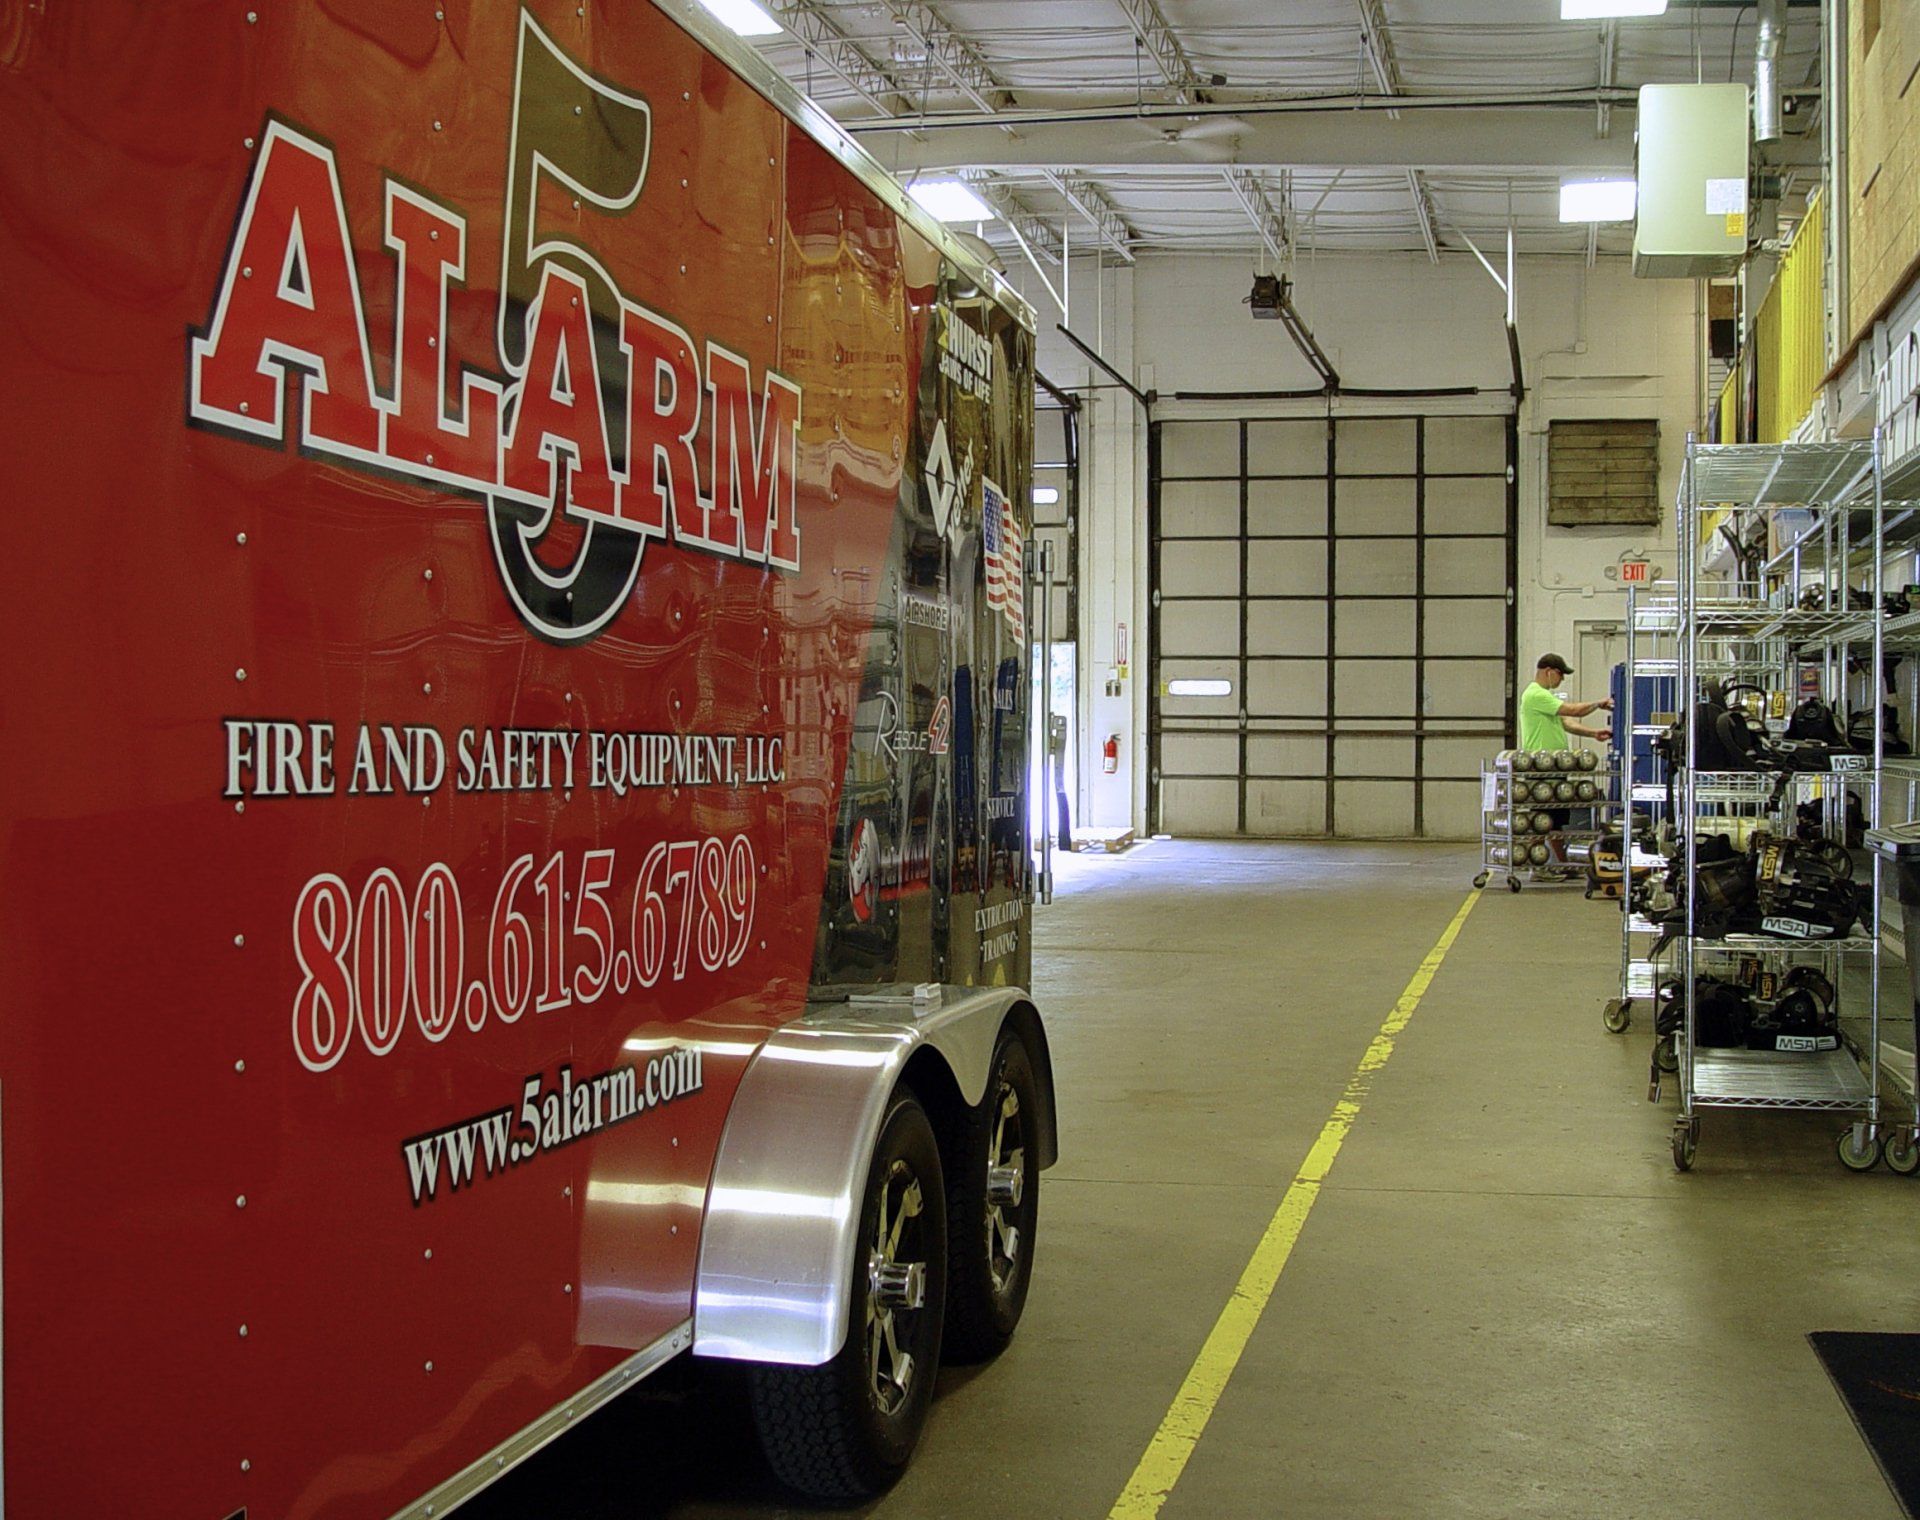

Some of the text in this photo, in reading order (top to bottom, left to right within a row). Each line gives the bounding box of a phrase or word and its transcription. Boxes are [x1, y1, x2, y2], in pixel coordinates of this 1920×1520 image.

[189, 117, 802, 572] ALARM
[948, 311, 993, 381] HURST
[939, 351, 992, 404] JAWS OF LIFE
[1623, 563, 1647, 581] EXIT
[223, 720, 786, 797] FIRE AND SAFETY EQUIPMENT, LLC.
[987, 796, 1015, 820] SERVICE
[1762, 844, 1780, 880] MSA
[975, 899, 1024, 932] EXTRICATION
[1764, 918, 1806, 935] MSA
[292, 833, 756, 1073] 800.615.6789
[983, 931, 1019, 962] TRAINING
[1778, 1037, 1815, 1050] MSA
[404, 1045, 703, 1201] www.5alarm.com
